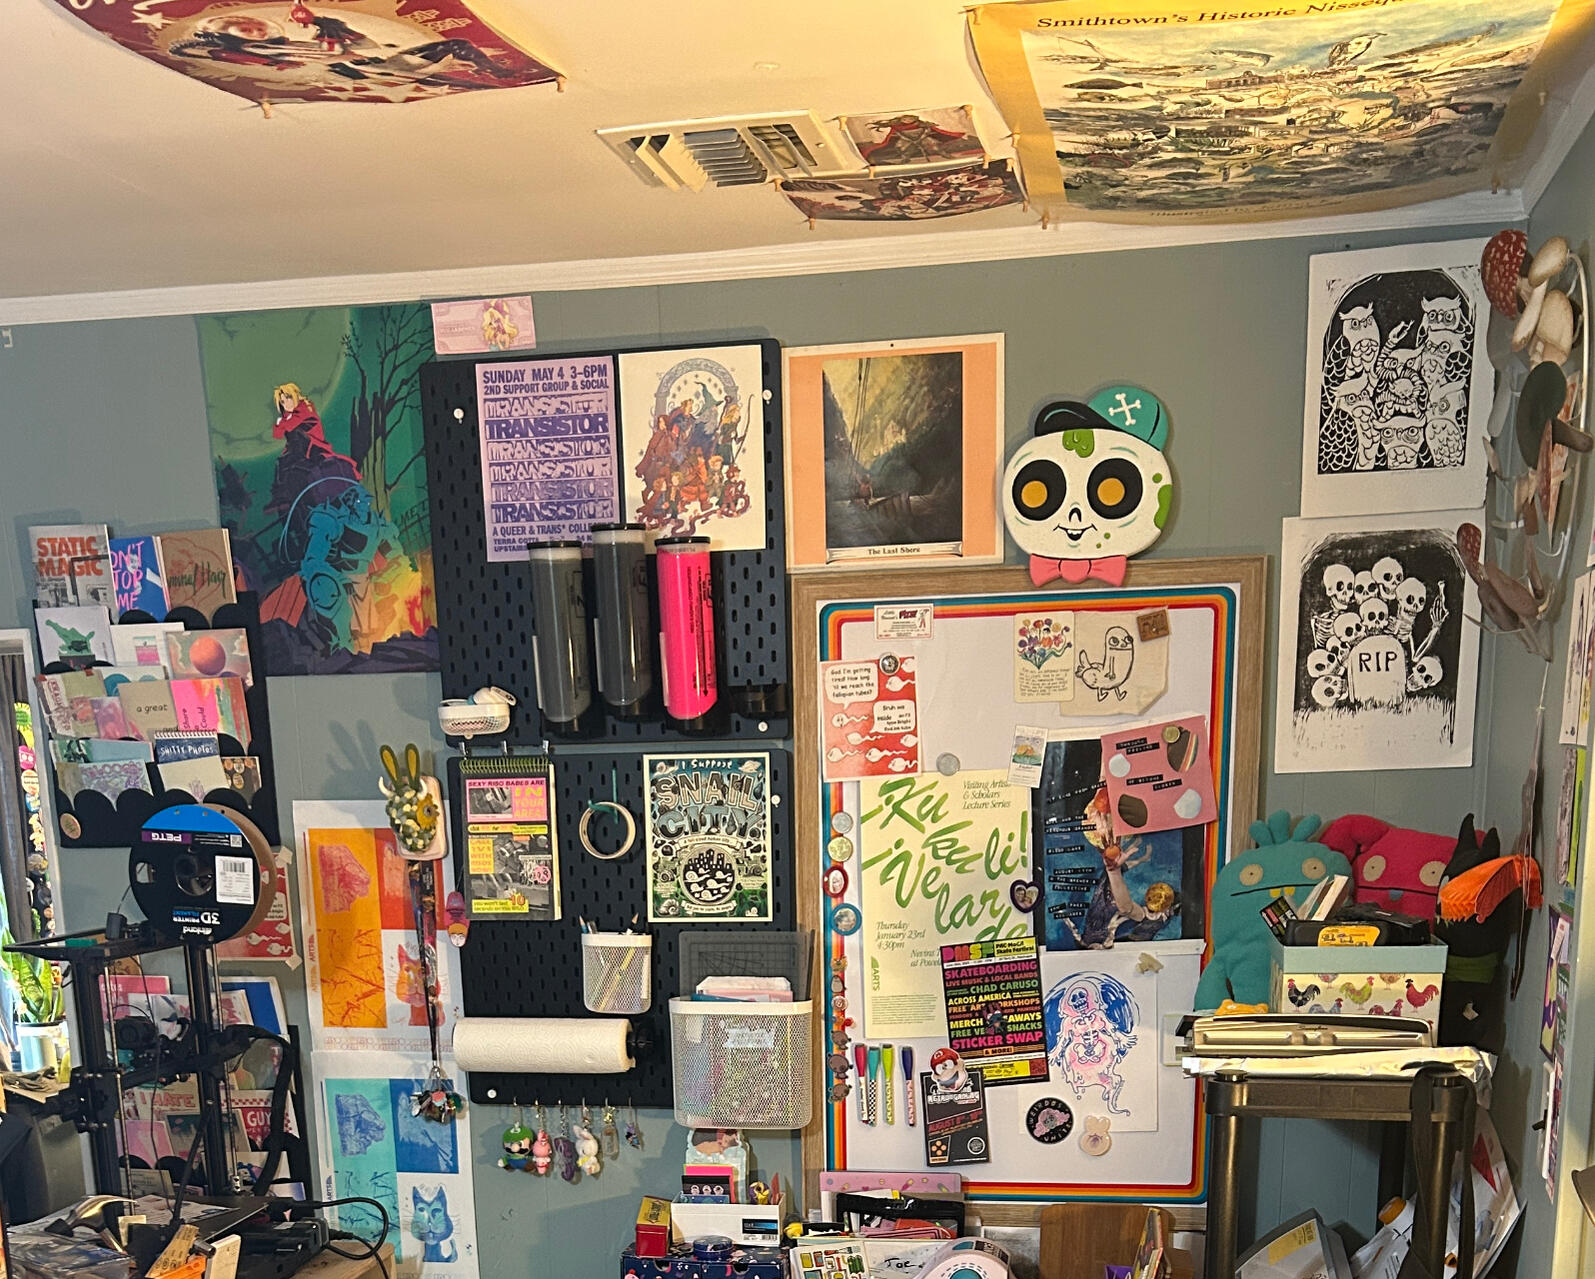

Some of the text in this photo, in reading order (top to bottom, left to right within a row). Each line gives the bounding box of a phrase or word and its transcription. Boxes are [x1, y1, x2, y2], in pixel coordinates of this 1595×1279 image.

[1037, 0, 1401, 28] Smithtown's Historic Nisseq
[483, 369, 526, 384] SUNDAY
[532, 367, 554, 381] MAY
[557, 366, 565, 379] 4
[484, 379, 609, 395] 2ND SUPPORT GROUP & SOCIAL
[485, 413, 609, 440] TRANSISTOR
[492, 528, 498, 536] A
[501, 526, 526, 536] QUEER
[528, 525, 535, 535] &
[37, 536, 103, 577] STATIC MAGIC
[110, 540, 144, 568] ON'T
[883, 547, 898, 555] Last
[900, 546, 920, 554] Shore
[116, 593, 139, 610] ME
[1358, 651, 1398, 673] RIP
[144, 704, 168, 714] great
[515, 787, 542, 797] IN
[655, 770, 759, 812] SNAIL
[963, 780, 988, 790] Visiting
[971, 790, 1001, 799] Scholars
[963, 800, 1011, 809] Lecture Series
[657, 804, 763, 839] CITY
[151, 831, 182, 842] PETG
[200, 911, 221, 925] 3D
[876, 920, 909, 931] Thursday
[876, 929, 927, 941] January 23rd
[942, 942, 994, 962] PMSF
[945, 961, 1037, 980] SKATEBOARDING
[961, 978, 984, 986] MUSIC
[991, 974, 1013, 983] LOCAL
[1014, 971, 1038, 980] BANDS
[872, 968, 880, 992] ARTS
[970, 979, 1039, 994] CHAD CARUSO
[948, 992, 1012, 1006] ACROSS AMERICA
[948, 998, 1040, 1014] FREE ORKSHOPS
[950, 1018, 984, 1029] MERCH
[951, 1022, 1042, 1038] FREE SNACKS
[952, 1031, 1043, 1049] STICKER SWAP
[1029, 1100, 1062, 1124] WEIRDOS
